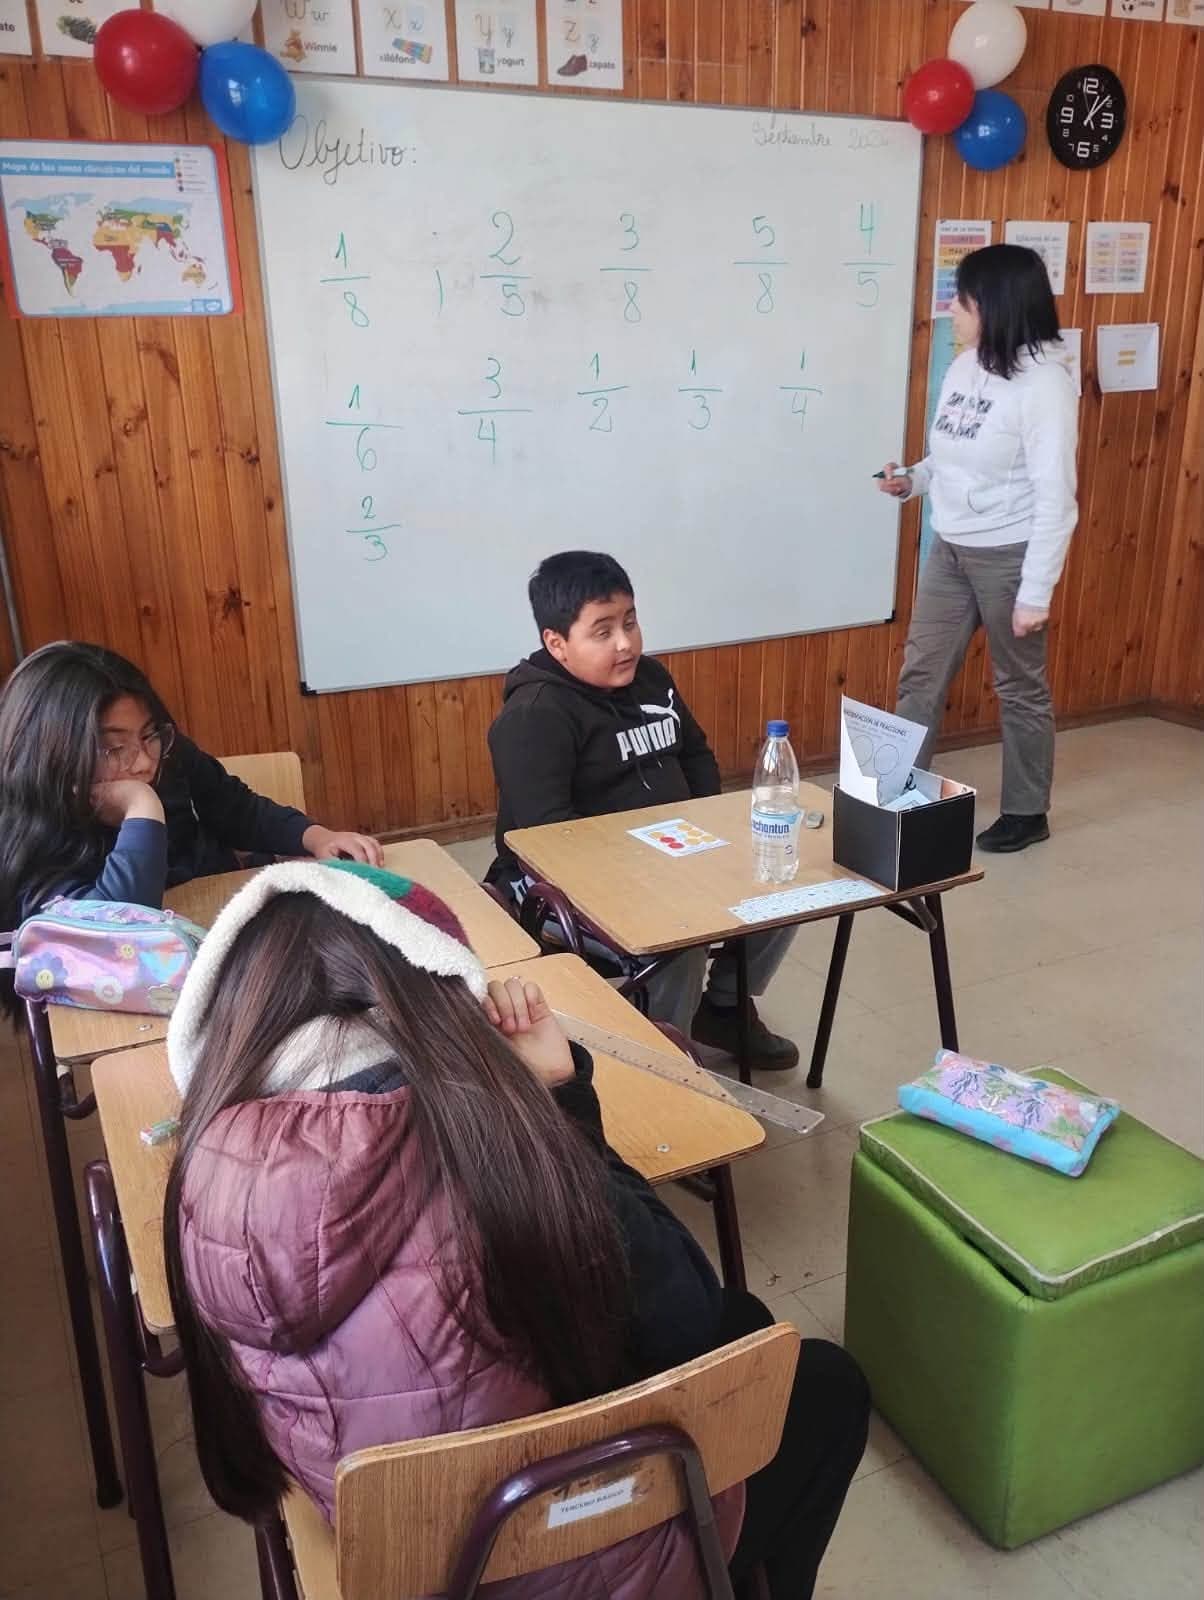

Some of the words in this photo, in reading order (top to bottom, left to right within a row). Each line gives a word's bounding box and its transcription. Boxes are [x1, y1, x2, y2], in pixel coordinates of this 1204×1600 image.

[304, 41, 338, 53] Winnie
[1060, 106, 1075, 124] 9
[1100, 111, 1115, 129] 3
[278, 114, 418, 186] Objetivo:
[1076, 141, 1091, 158] 6
[488, 211, 521, 266] 2
[619, 212, 640, 251] 3
[752, 215, 776, 248] 5
[860, 202, 875, 256] 4
[335, 231, 347, 269] 1
[500, 283, 526, 317] 5
[623, 281, 642, 323] 8
[755, 272, 775, 314] 8
[855, 271, 880, 308] 5
[343, 291, 370, 328] 8
[484, 356, 502, 399] 3
[589, 352, 600, 382] 1
[349, 384, 361, 409] 1
[588, 397, 613, 433] 2
[687, 394, 712, 431] 3
[791, 391, 808, 433] 4
[356, 426, 378, 473] 6
[477, 418, 497, 465] 4
[361, 495, 377, 519] 2
[362, 534, 388, 562] 3
[616, 716, 677, 761] PUMA
